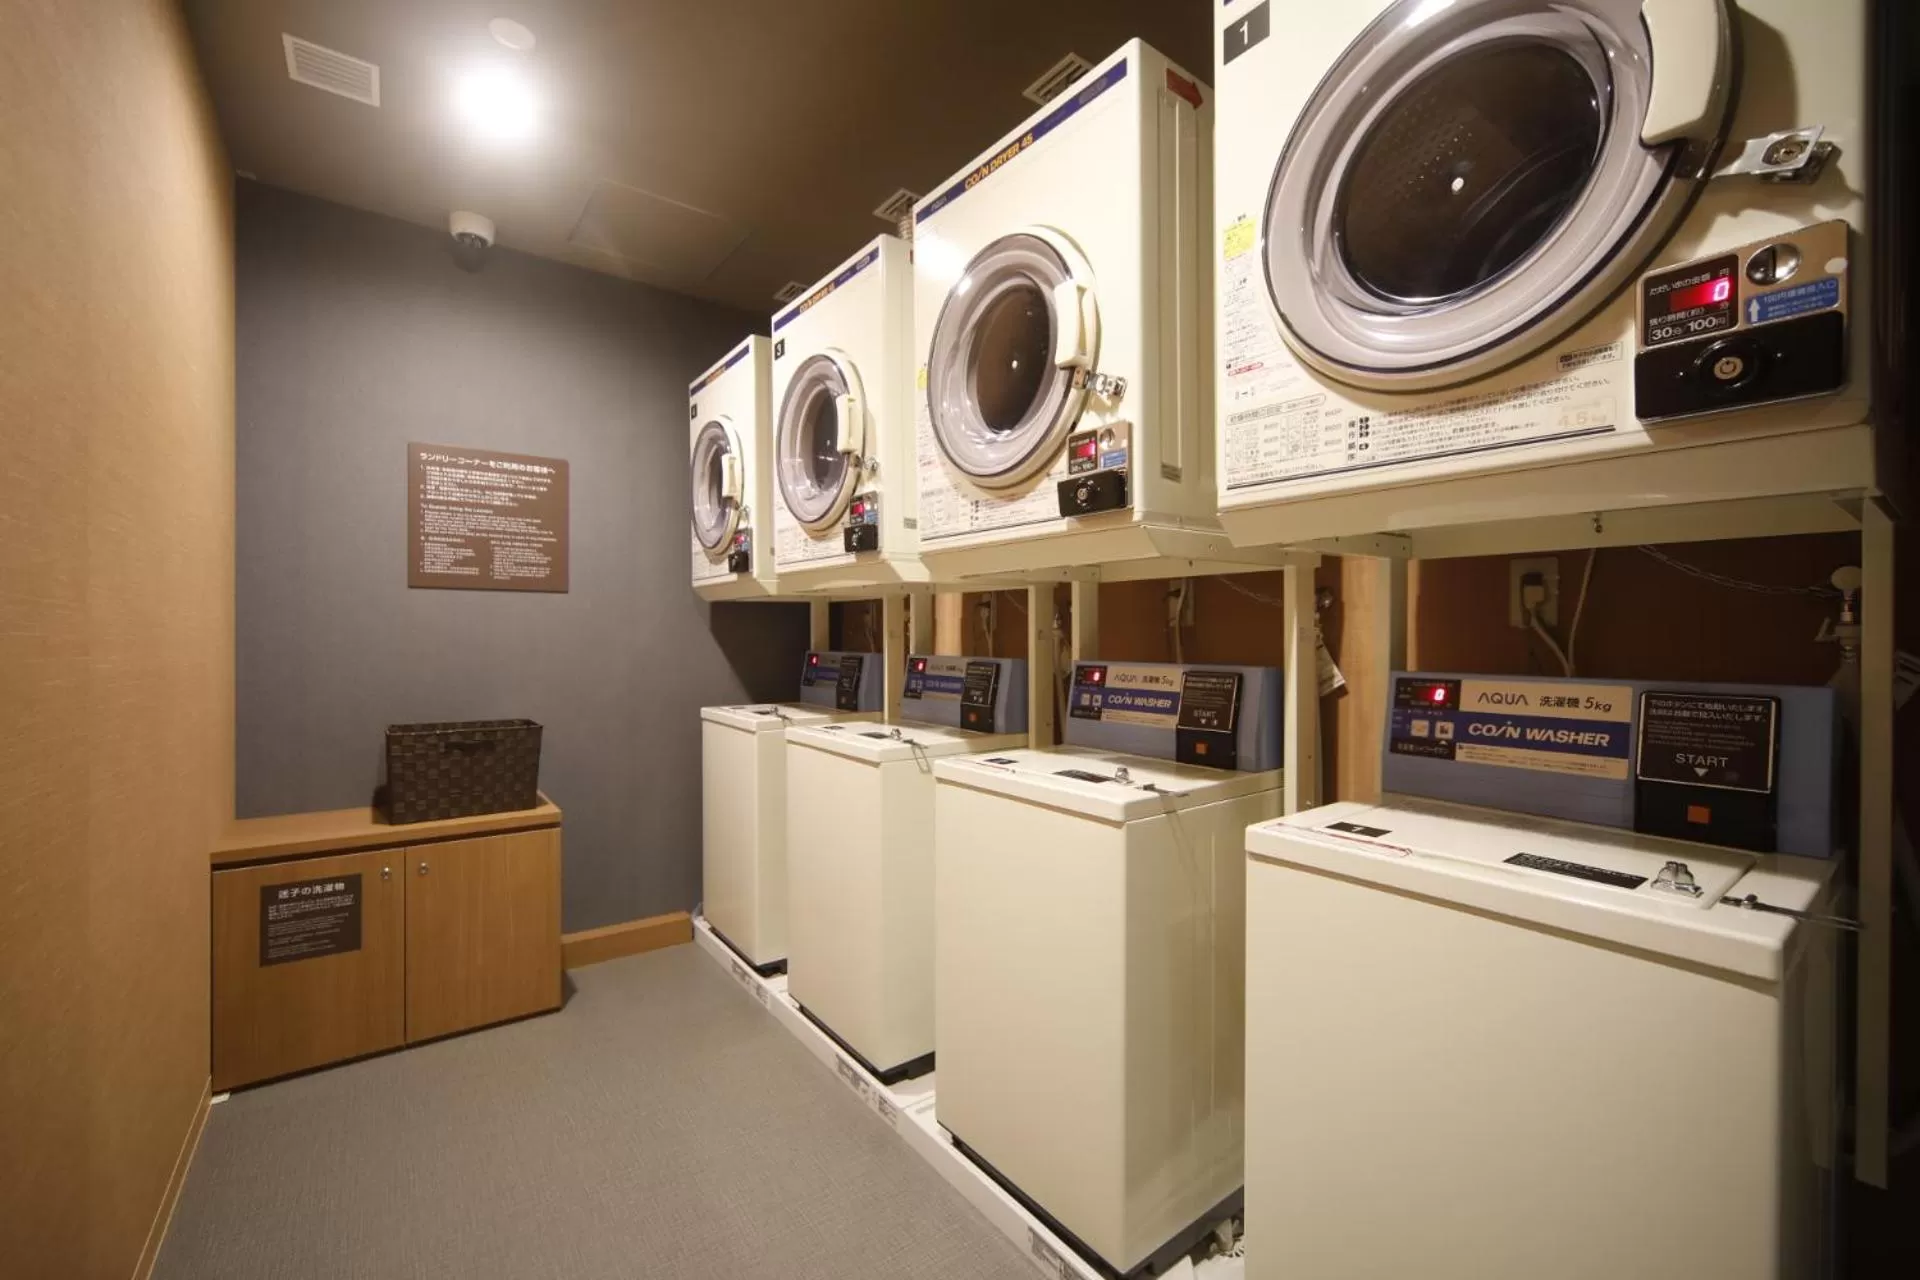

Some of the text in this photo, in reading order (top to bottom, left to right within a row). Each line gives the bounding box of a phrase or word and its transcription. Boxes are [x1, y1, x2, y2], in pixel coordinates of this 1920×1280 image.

[1239, 20, 1249, 46] 1
[990, 142, 1020, 172] DRYER
[1713, 278, 1730, 302] 0
[1113, 672, 1138, 684] AQUA
[1133, 696, 1173, 709] WASHER
[1477, 691, 1613, 713] AQUA 洗濯機 5kg
[1192, 709, 1218, 719] START
[1525, 727, 1611, 747] WASHER
[1674, 753, 1729, 768] START
